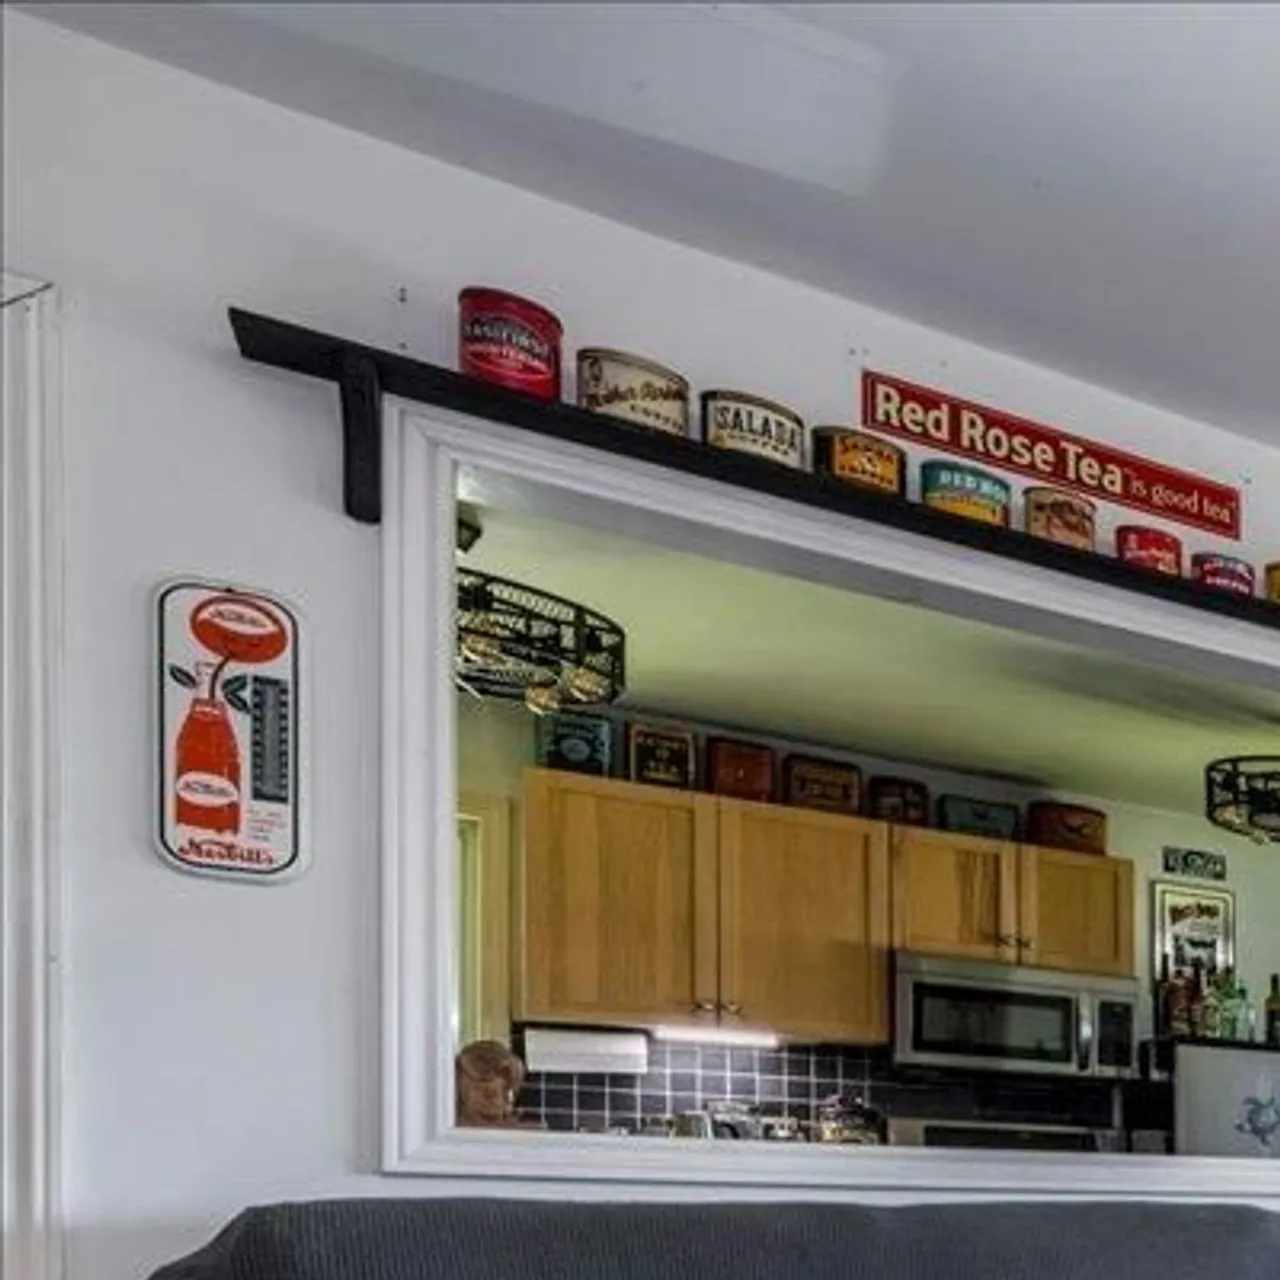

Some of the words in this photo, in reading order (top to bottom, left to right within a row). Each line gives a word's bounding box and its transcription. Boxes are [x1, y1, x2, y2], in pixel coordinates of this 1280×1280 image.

[874, 383, 950, 442] Red
[960, 408, 1055, 474] Rose
[1059, 440, 1123, 495] Tea
